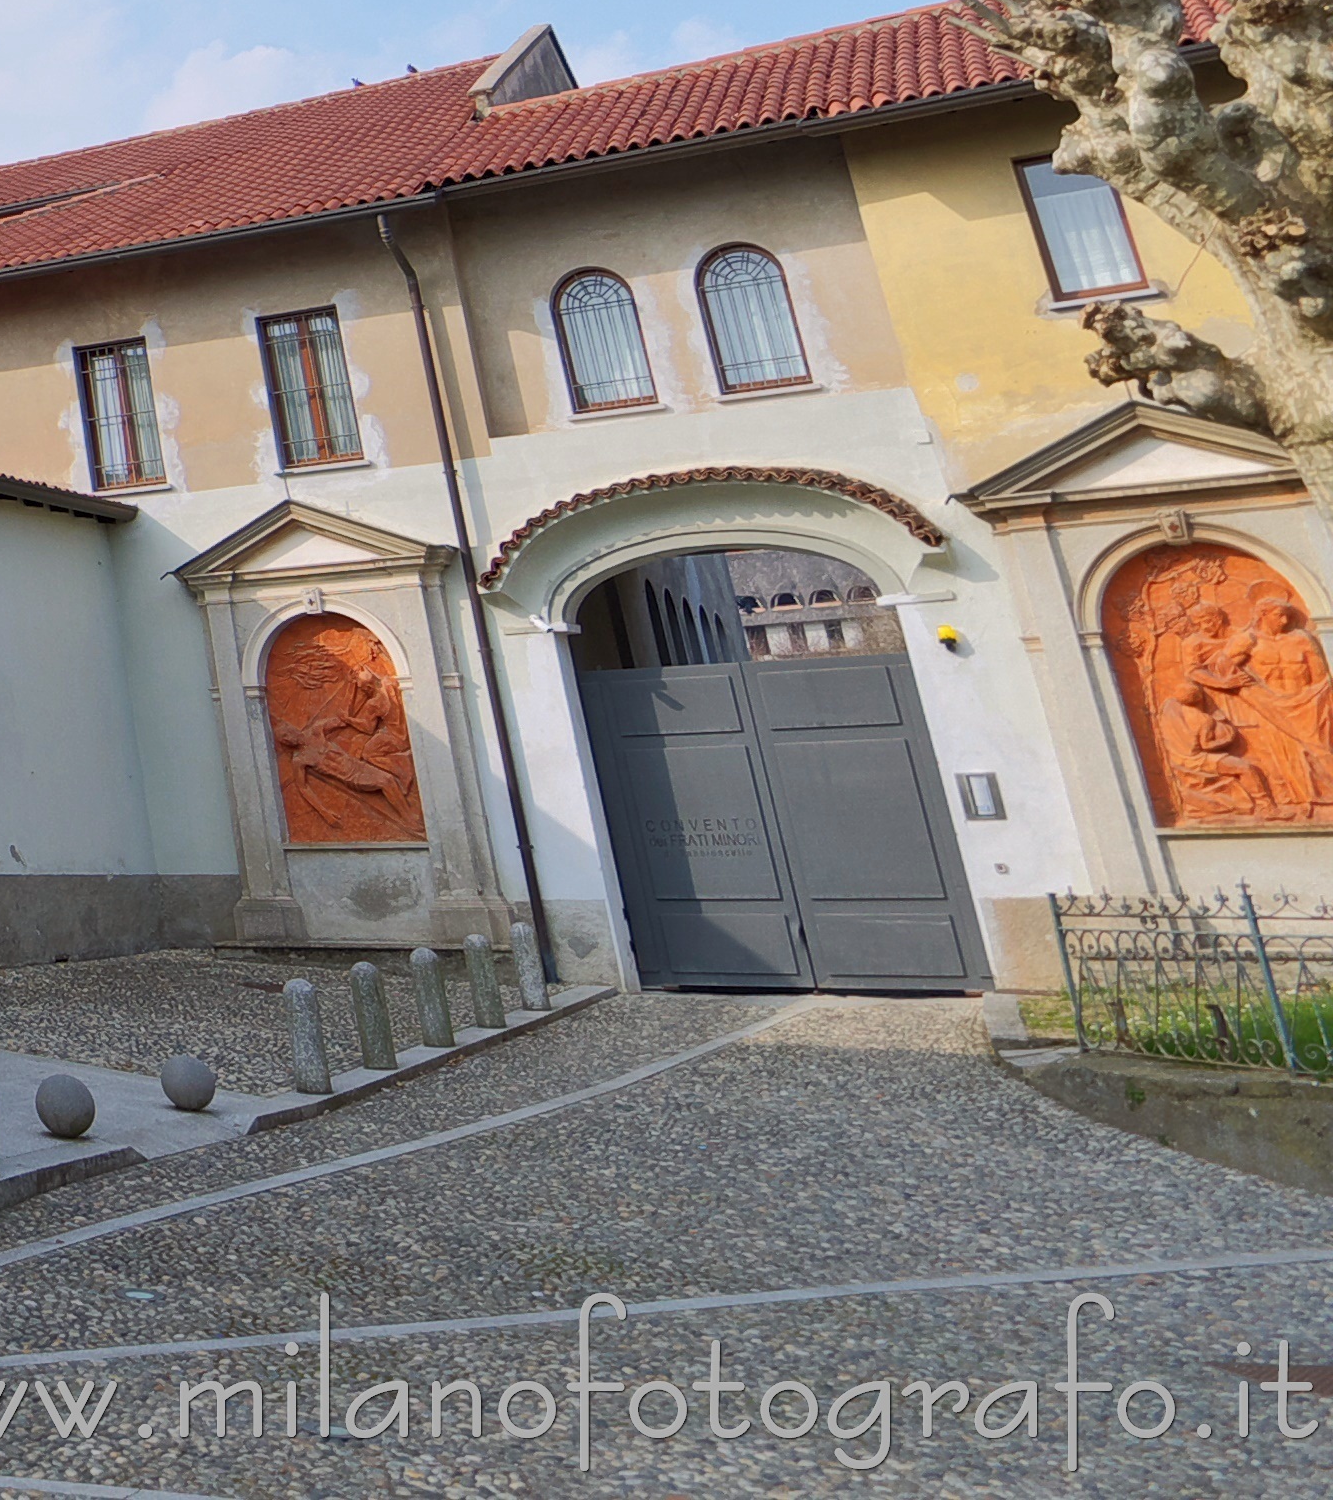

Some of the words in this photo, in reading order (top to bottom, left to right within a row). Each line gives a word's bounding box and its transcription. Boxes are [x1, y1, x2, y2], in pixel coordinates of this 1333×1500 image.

[645, 818, 757, 832] CONVENTO
[669, 834, 709, 847] FRATI
[711, 833, 760, 846] MINORI
